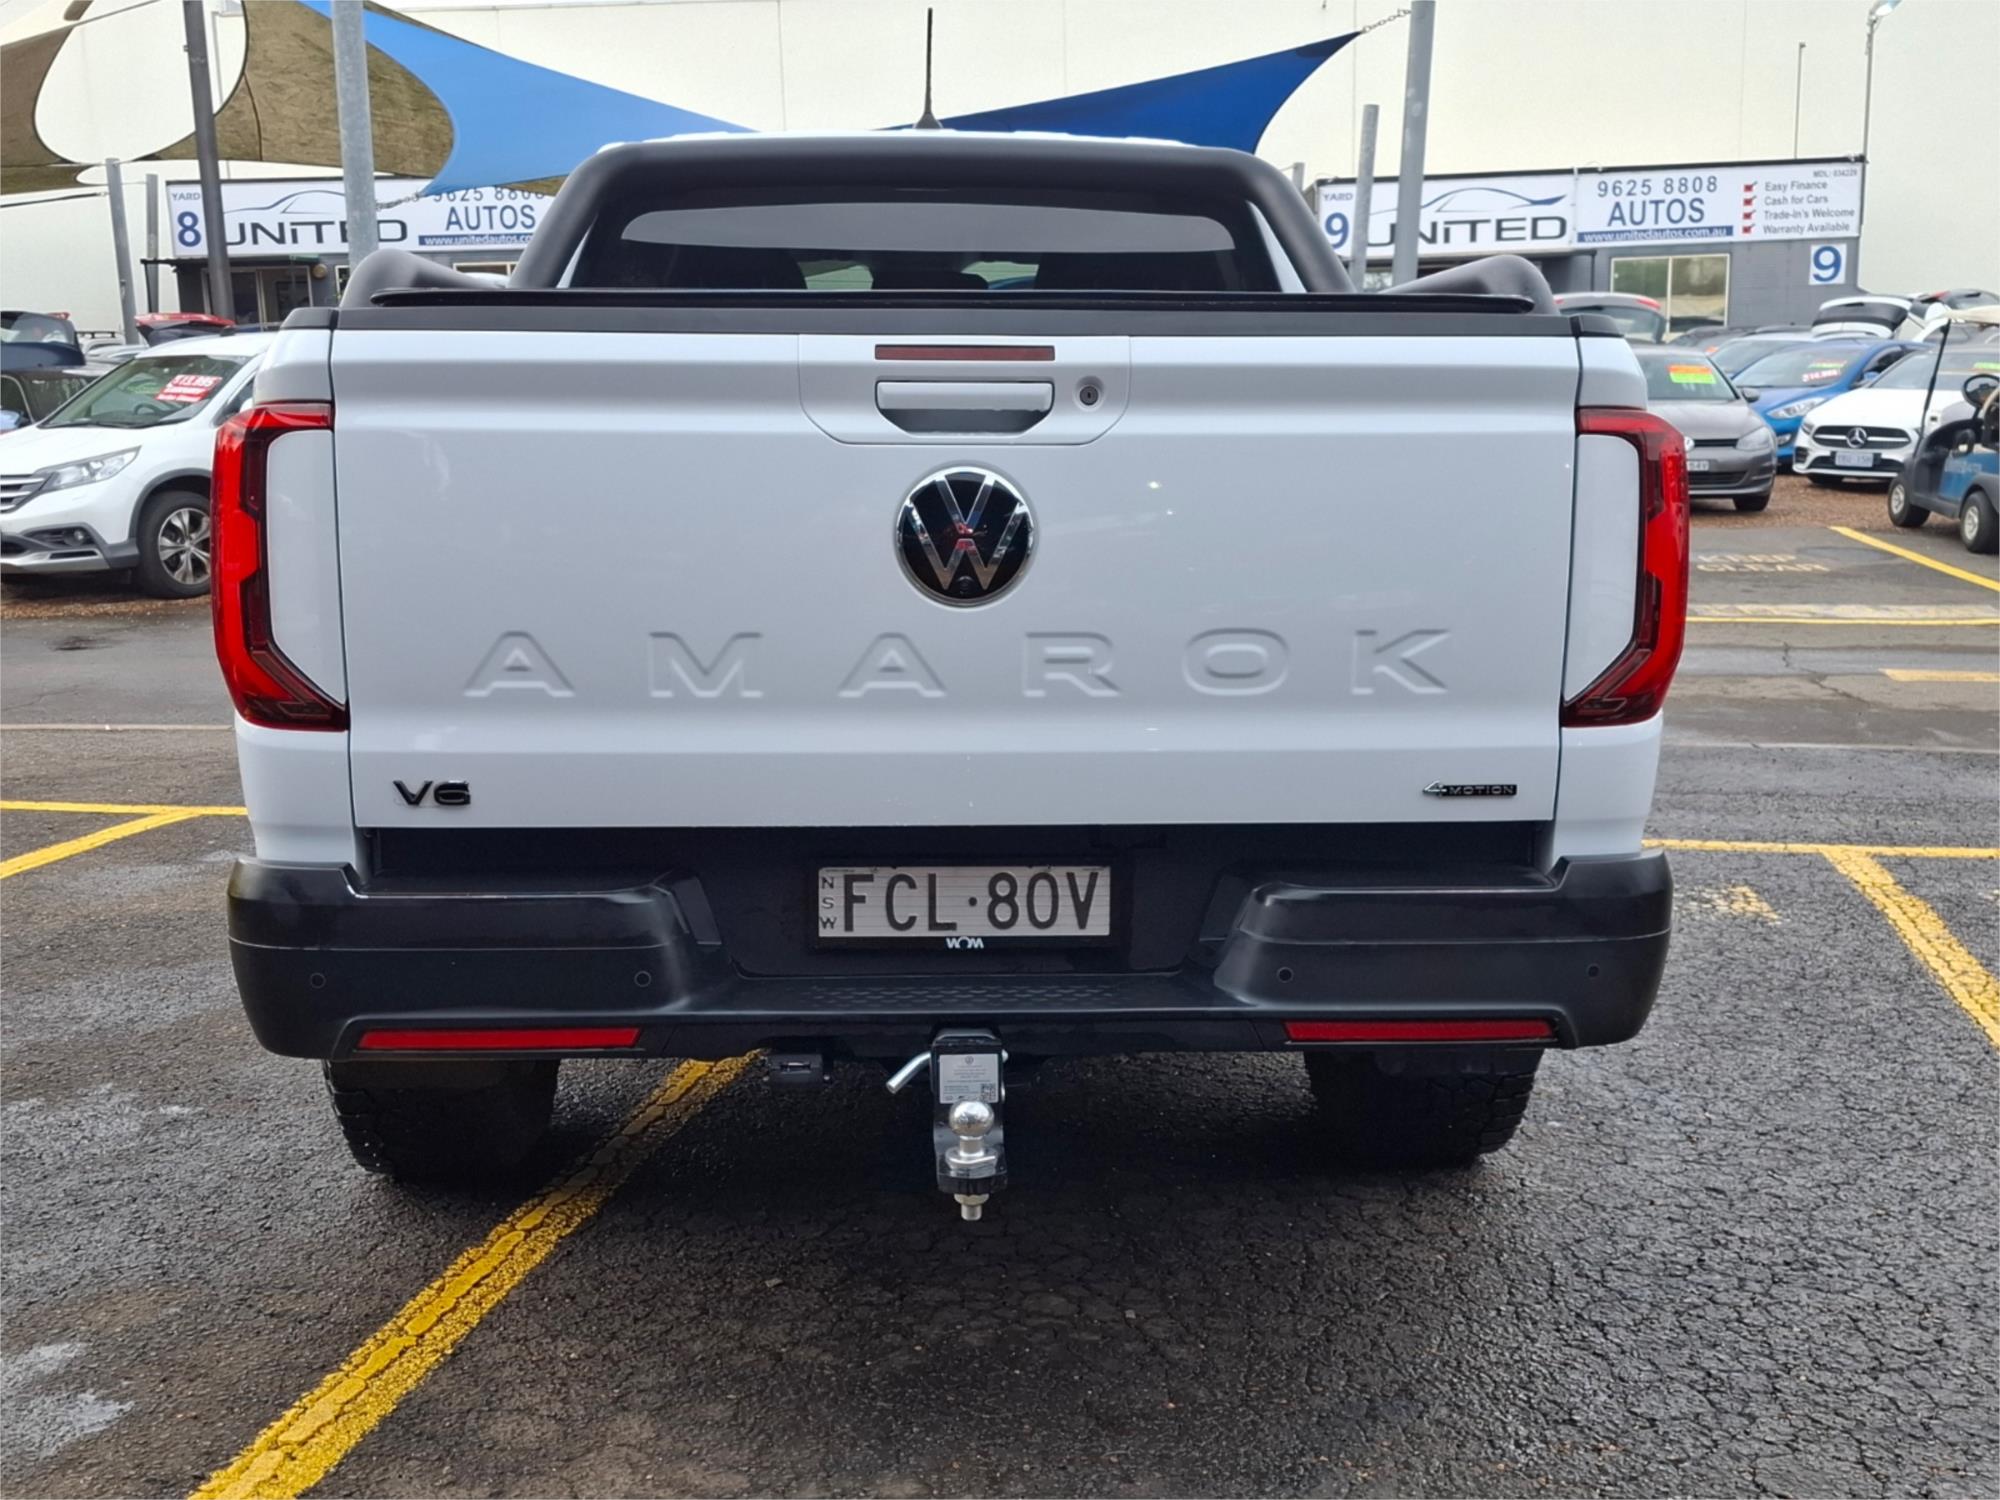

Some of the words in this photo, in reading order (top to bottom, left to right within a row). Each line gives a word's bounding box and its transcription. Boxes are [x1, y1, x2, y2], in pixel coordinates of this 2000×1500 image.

[172, 192, 201, 201] YARD
[1323, 192, 1354, 201] YARD
[1597, 179, 1652, 197] 9625
[1663, 175, 1718, 195] 8808
[1764, 181, 1788, 192] Easy
[1790, 180, 1828, 190] Finance
[1764, 195, 1789, 206] Cash
[1791, 195, 1804, 204] for
[1807, 194, 1829, 204] Cars
[446, 204, 536, 231] AUTOS
[1607, 198, 1705, 227] AUTOS
[1812, 208, 1855, 218] Welcome
[177, 211, 201, 247] 8
[1325, 212, 1349, 249] 9
[1583, 228, 1727, 243] www.unitedautos.com.au
[1763, 223, 1805, 235] Warranty
[1807, 222, 1850, 233] Available
[1813, 245, 1843, 283] 9
[464, 627, 1452, 699] AMAROK
[392, 780, 472, 806] V6
